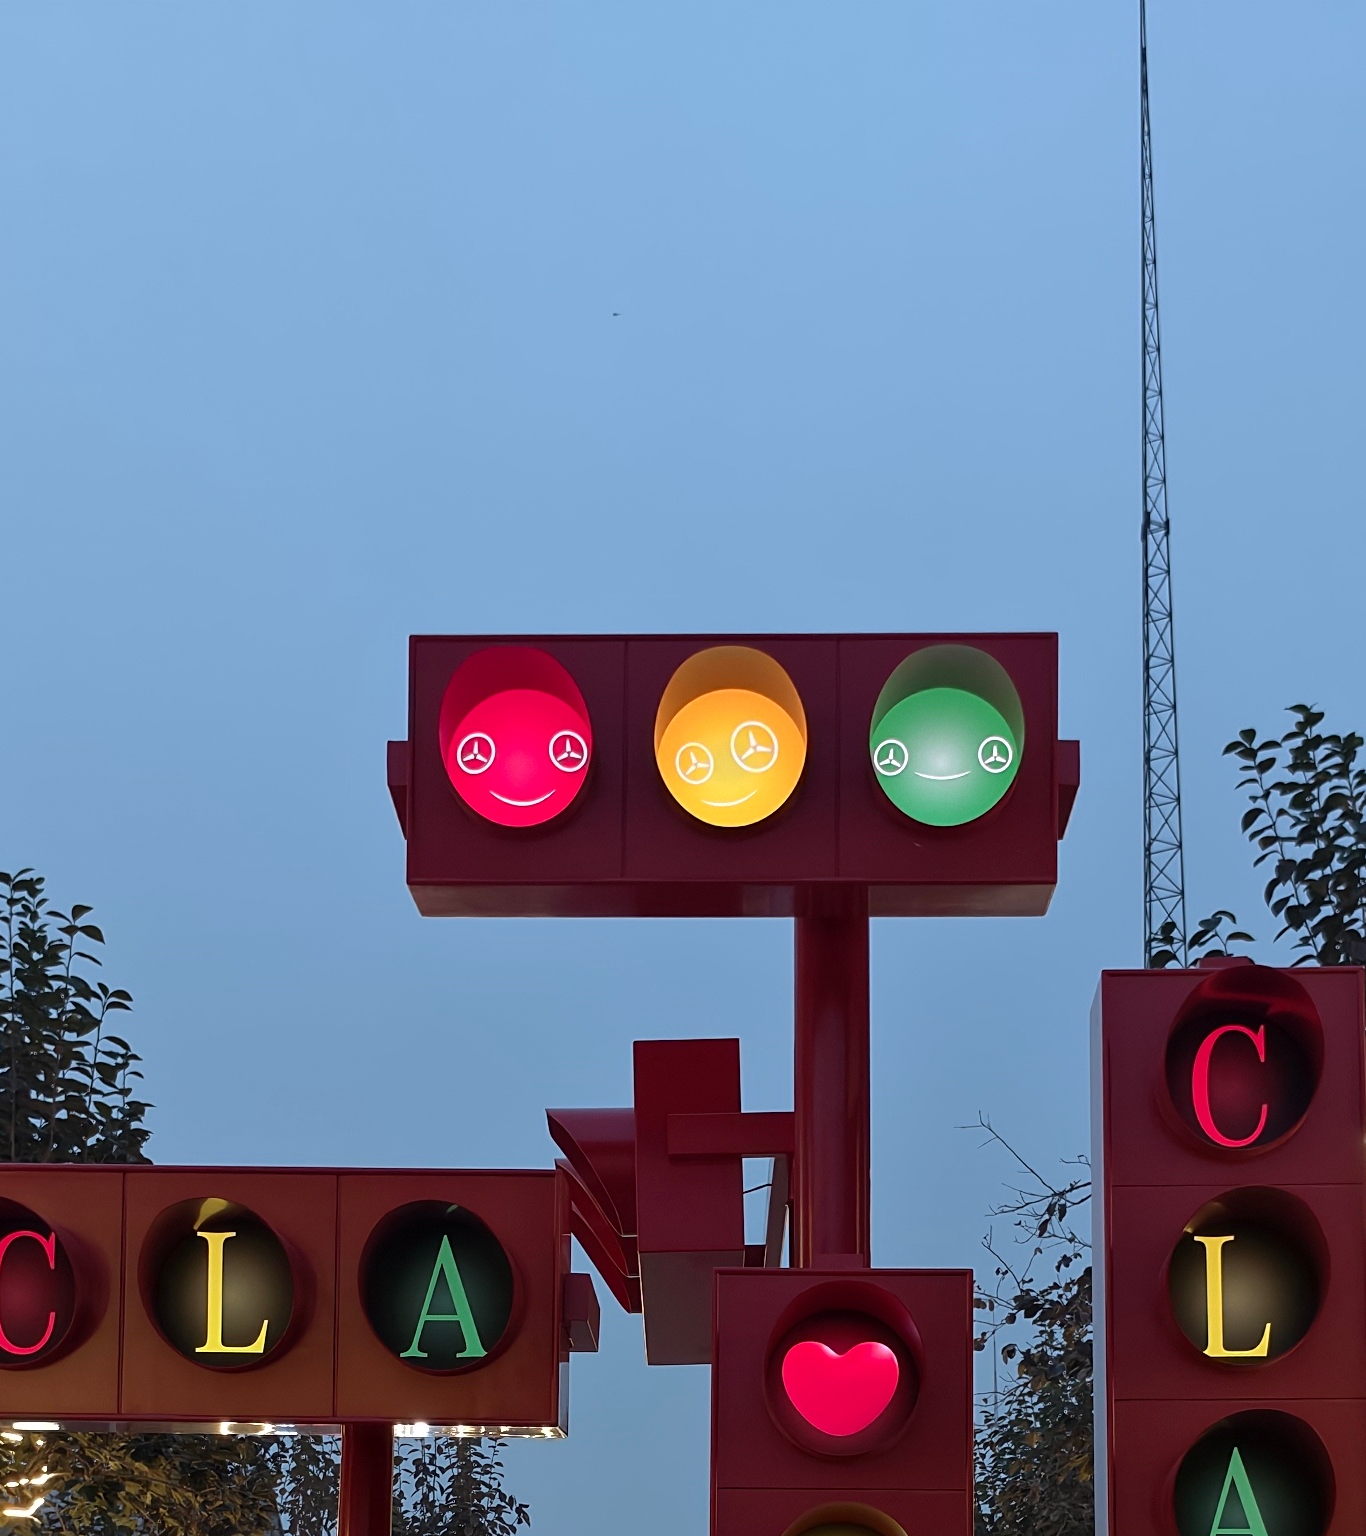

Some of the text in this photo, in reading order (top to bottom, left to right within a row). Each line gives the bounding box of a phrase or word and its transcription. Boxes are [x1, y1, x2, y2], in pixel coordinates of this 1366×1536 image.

[1192, 1024, 1269, 1148] C
[195, 1231, 269, 1354] L
[400, 1234, 488, 1359] A
[1194, 1235, 1272, 1358] L
